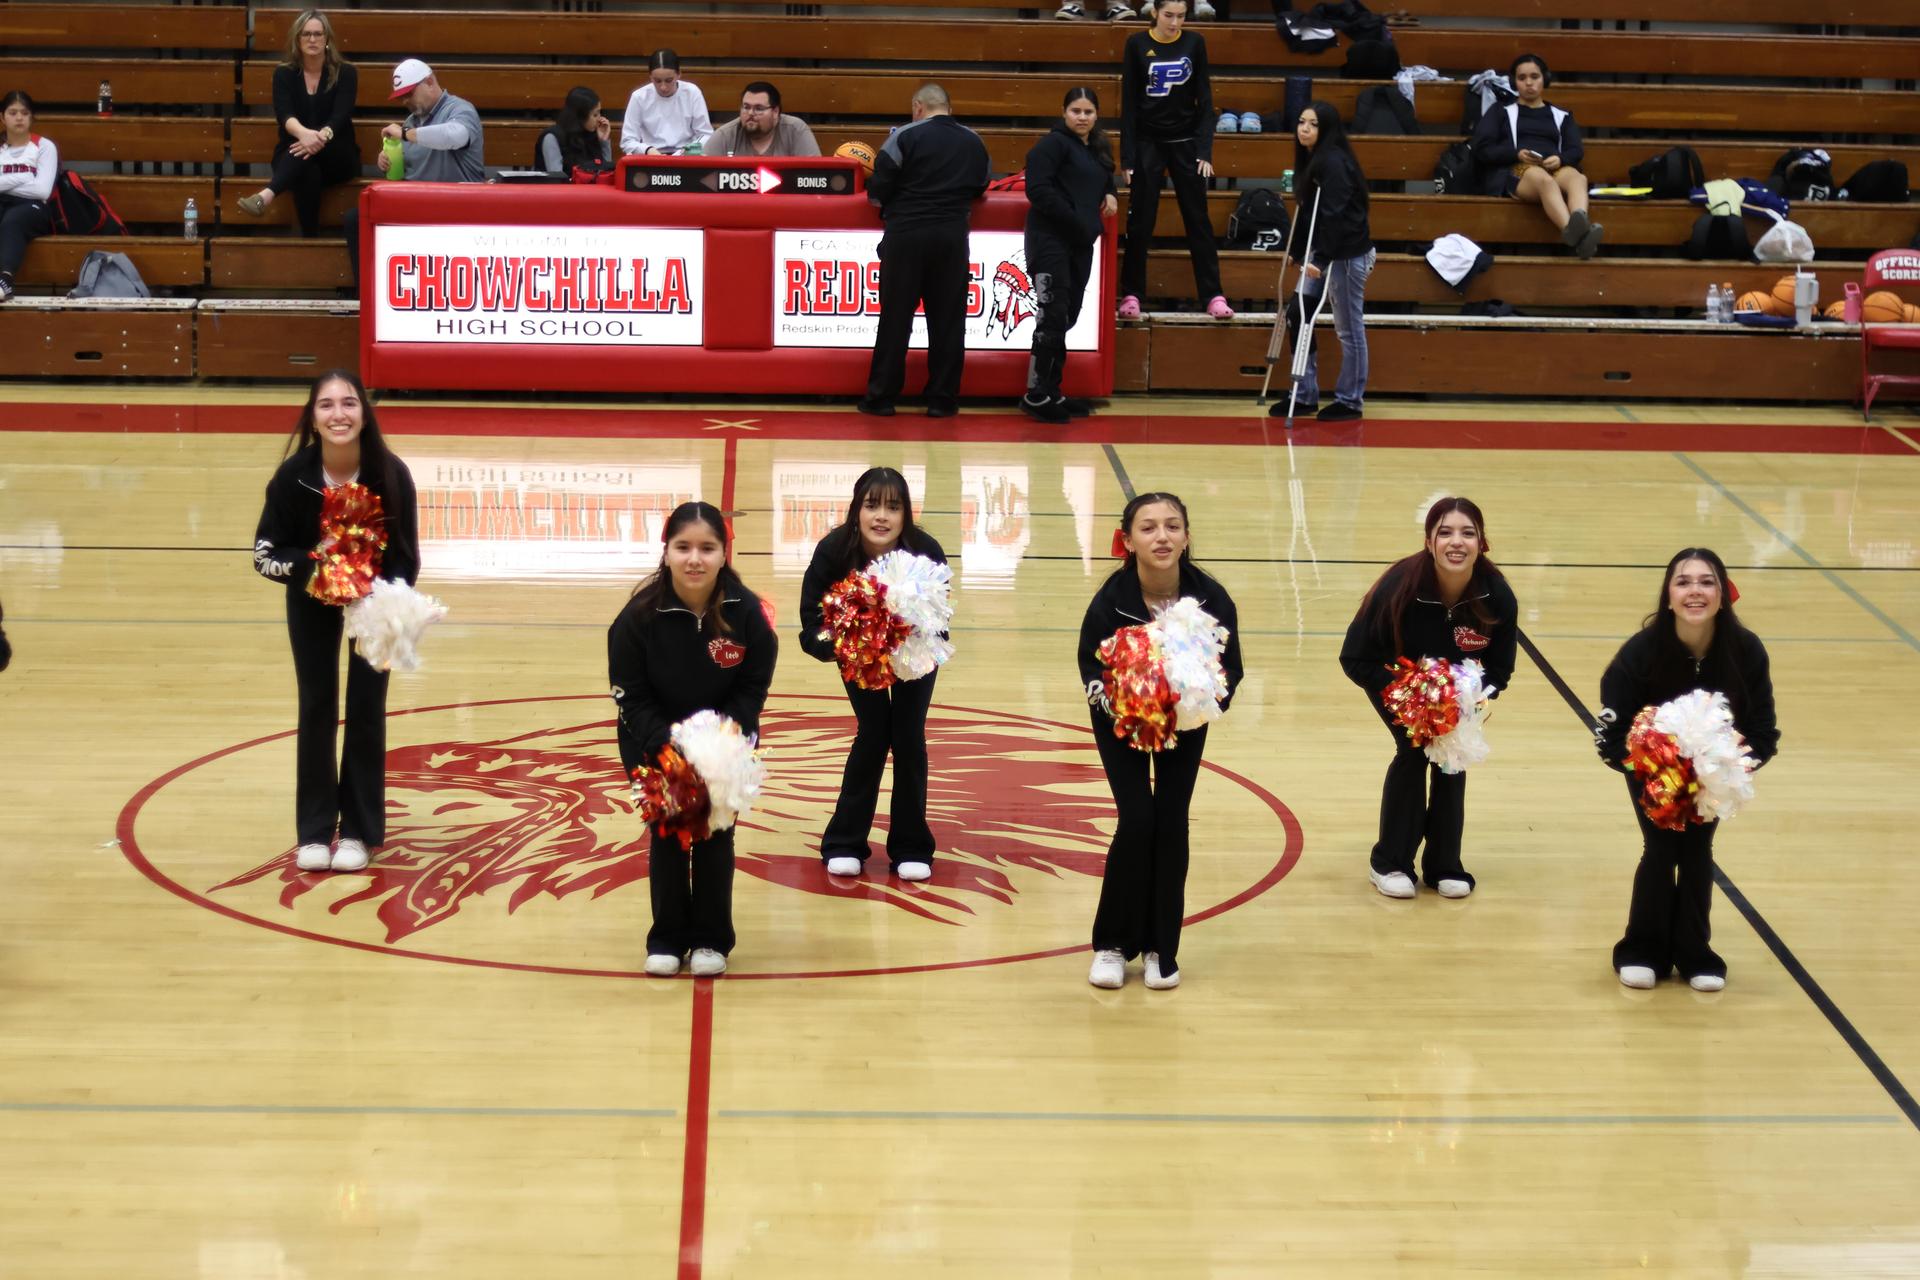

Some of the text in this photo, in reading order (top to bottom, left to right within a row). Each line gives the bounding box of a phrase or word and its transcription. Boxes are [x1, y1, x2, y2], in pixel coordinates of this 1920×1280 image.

[1146, 57, 1193, 97] P
[849, 148, 872, 163] NCAA
[651, 175, 682, 186] BONUS
[719, 172, 760, 190] POSS
[797, 177, 828, 188] BONUS
[800, 239, 837, 251] FCA
[387, 253, 693, 315] CHOWCHILLA
[436, 319, 643, 337] HIGH SCHOOL
[782, 323, 833, 334] Redskin
[837, 324, 870, 335] Pride
